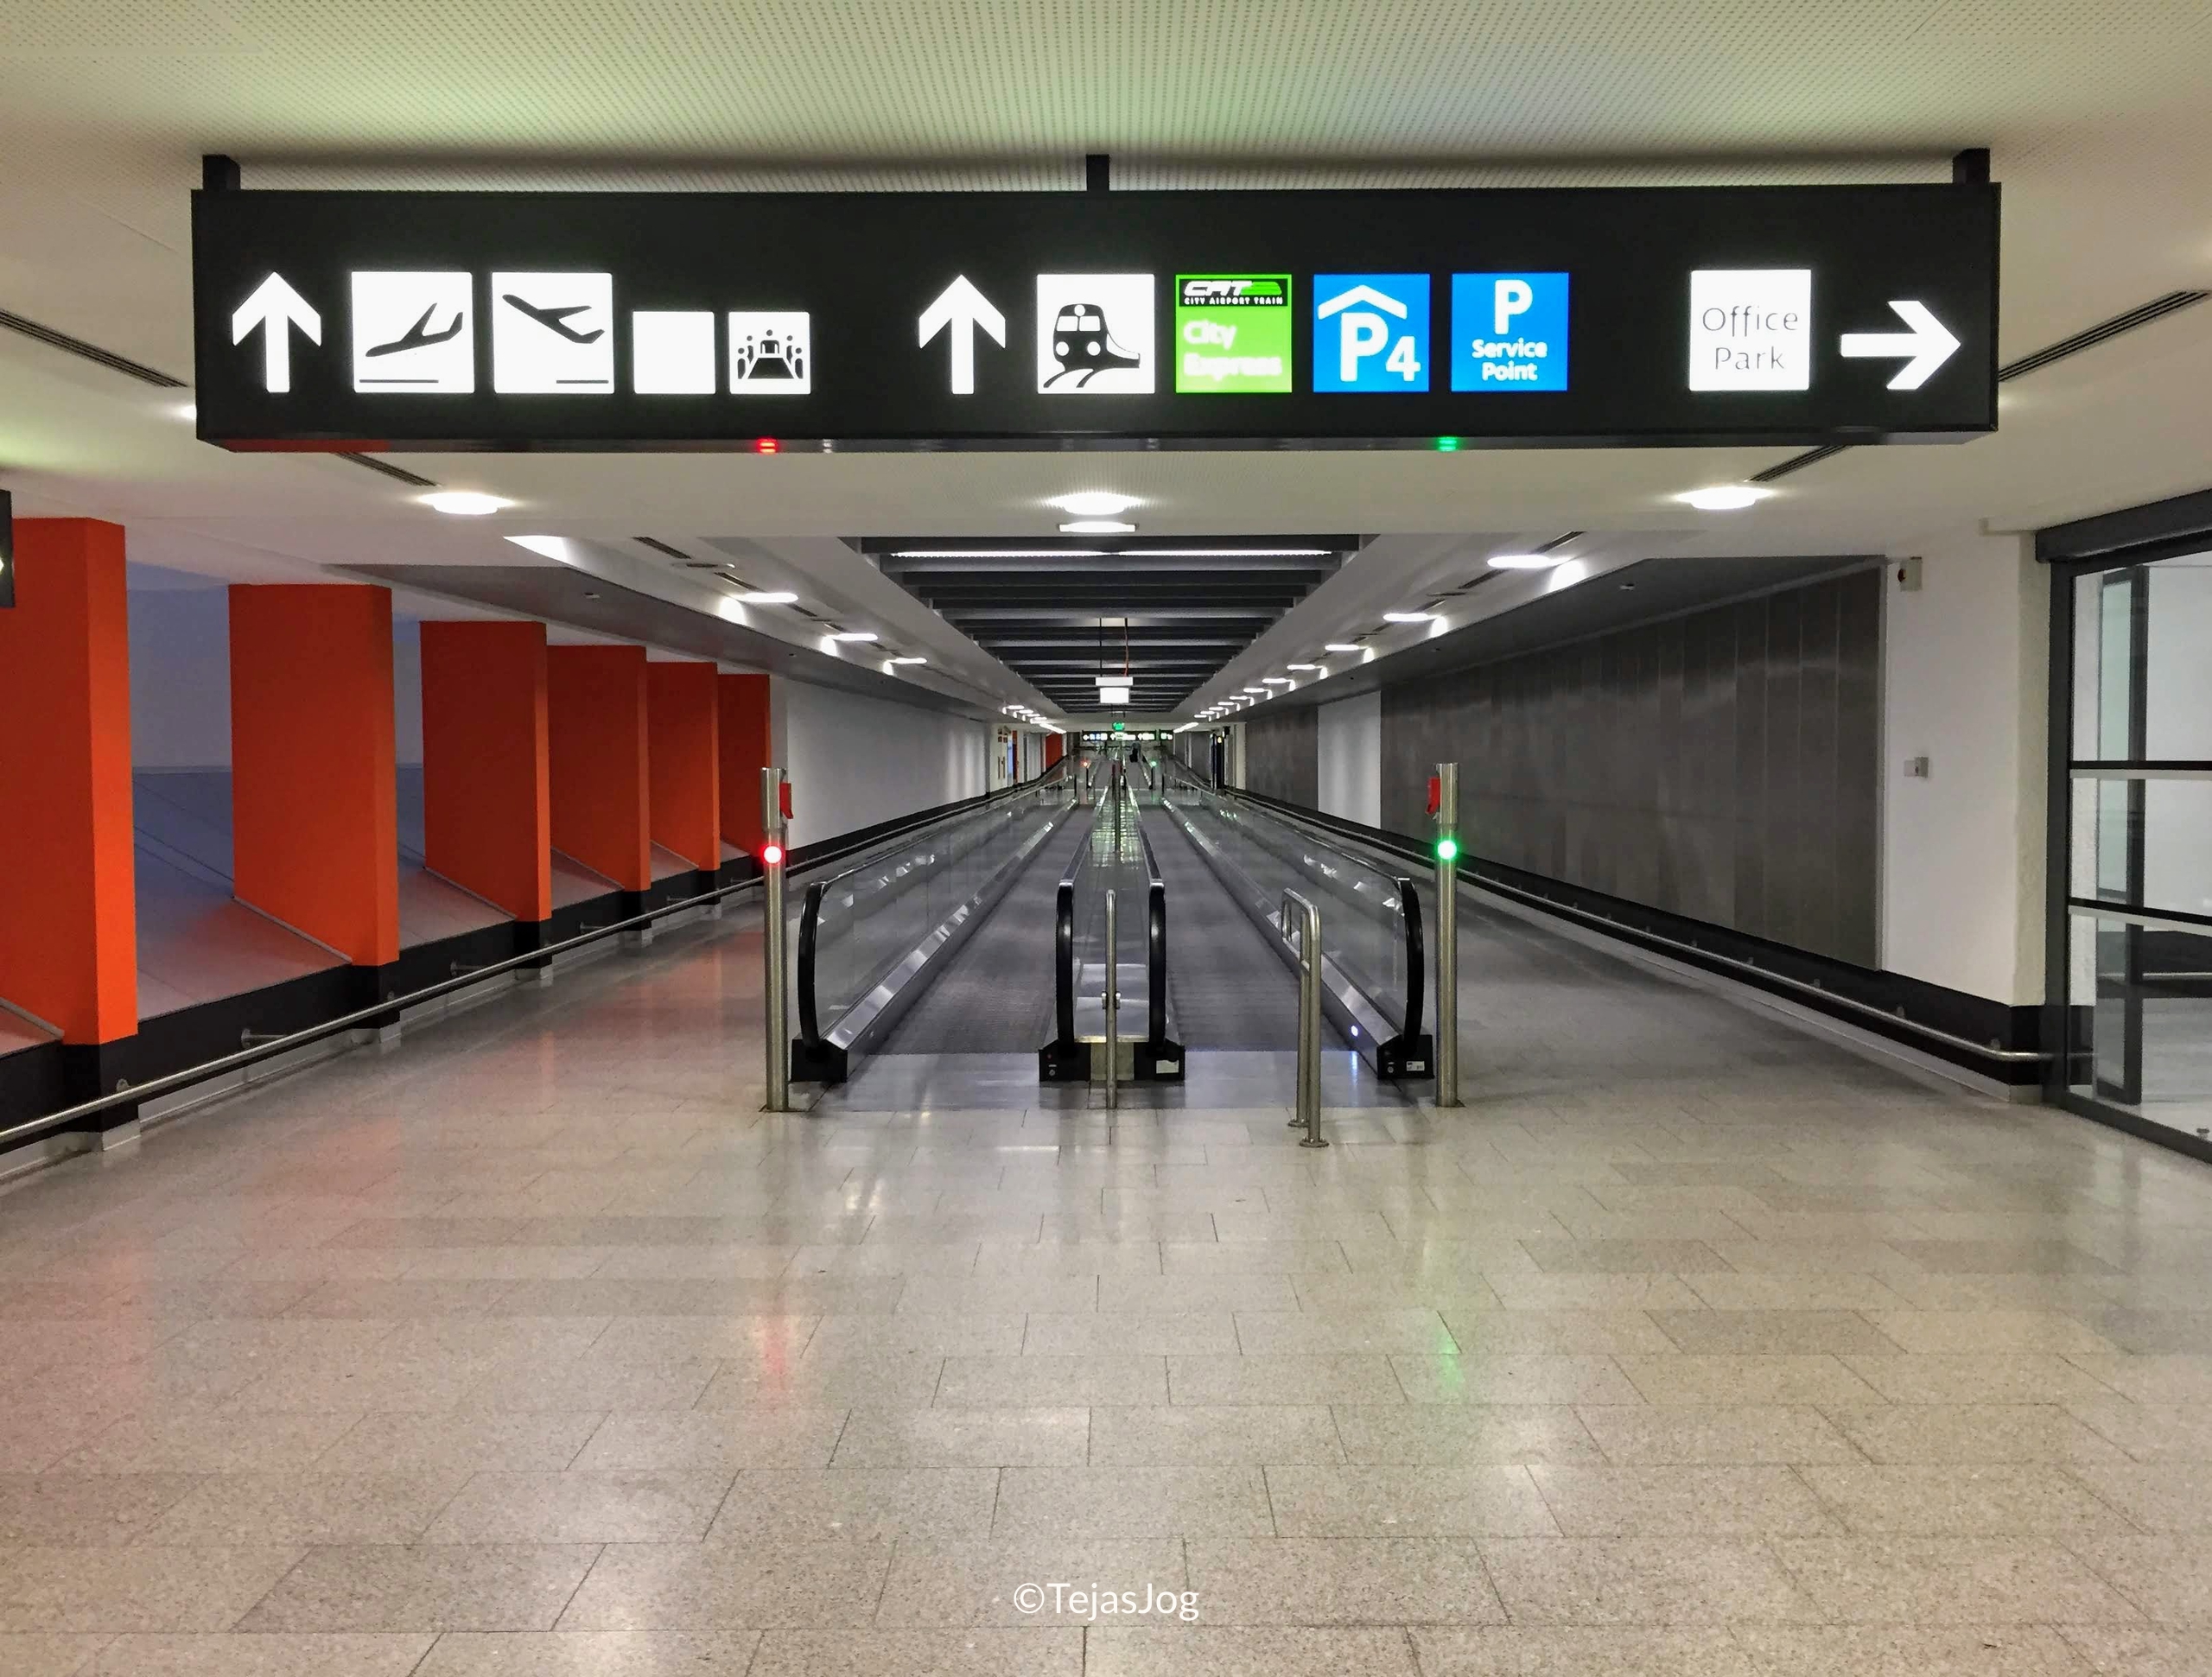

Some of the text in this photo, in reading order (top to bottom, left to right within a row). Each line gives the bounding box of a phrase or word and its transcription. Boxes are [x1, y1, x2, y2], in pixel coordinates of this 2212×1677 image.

[1495, 279, 1533, 334] P
[1702, 305, 1798, 337] Office
[1184, 320, 1236, 349] City
[1471, 339, 1548, 359] Service
[1715, 346, 1785, 370] Park
[1482, 361, 1538, 381] Point
